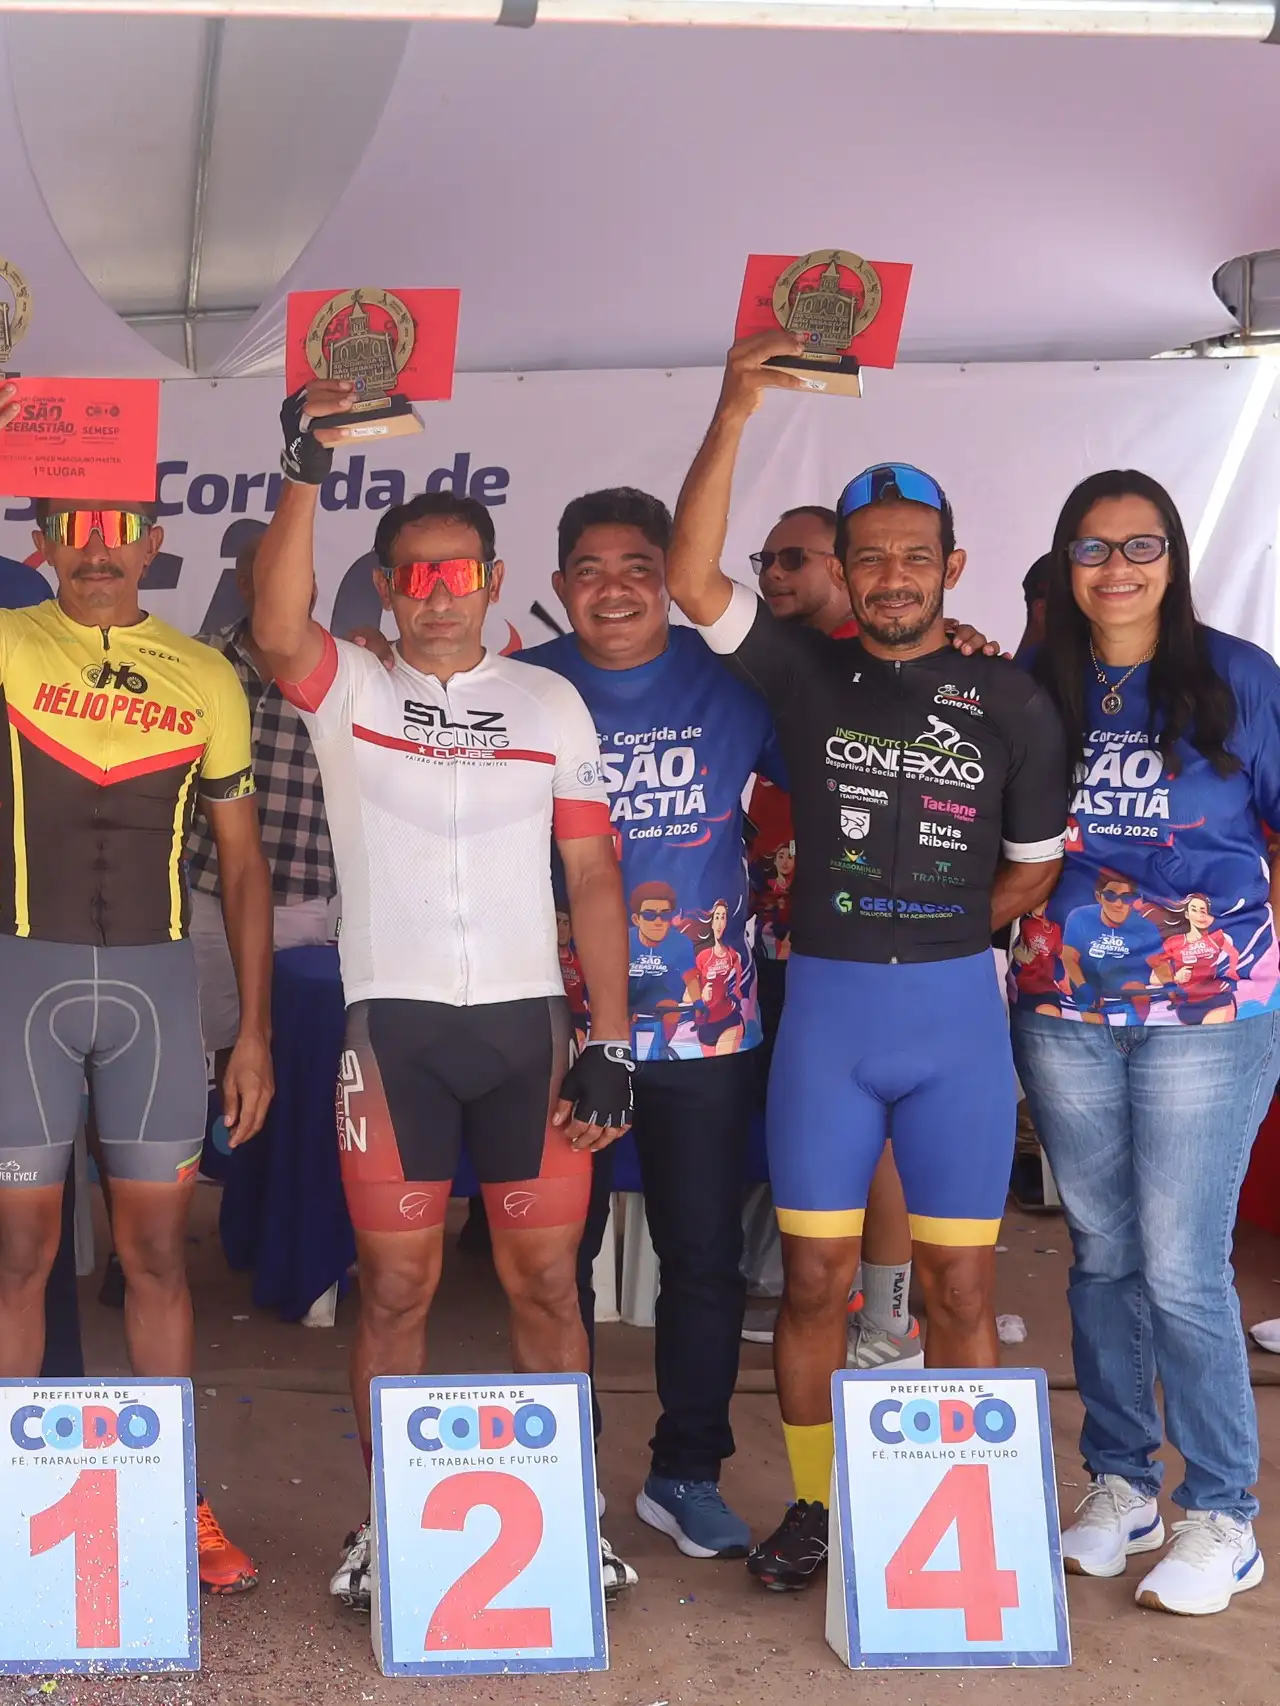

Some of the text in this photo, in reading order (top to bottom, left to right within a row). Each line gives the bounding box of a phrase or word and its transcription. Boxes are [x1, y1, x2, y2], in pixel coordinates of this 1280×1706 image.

[22, 402, 63, 421] SÃO
[5, 421, 75, 434] SEBASTIÃO
[82, 426, 120, 435] SEMESP
[47, 467, 86, 477] LUGAR
[156, 452, 510, 517] Corrda de
[33, 683, 197, 735] HÉLIO PEÇAS
[403, 699, 508, 732] SLZ
[403, 724, 510, 748] CYCLING
[613, 726, 677, 746] Corrida
[680, 726, 702, 740] de
[835, 726, 909, 750] INSTITUTO
[1088, 729, 1149, 744] Corrida
[433, 749, 496, 759] CLUBE
[599, 741, 696, 794] SÃO
[825, 757, 864, 772] Desportiva
[871, 766, 898, 779] Social
[905, 772, 916, 780] de
[918, 773, 976, 791] Paragominas
[839, 784, 889, 800] SCANIA
[609, 783, 707, 822] ASTIÃ
[921, 795, 977, 817] Tatiane
[1070, 787, 1170, 820] ASTIÃ
[628, 822, 699, 840] Codó 2026
[919, 821, 962, 839] Elvis
[1088, 822, 1122, 835] Codó
[1123, 825, 1159, 838] 2026
[919, 834, 968, 851] Ribeiro
[13, 1170, 38, 1182] CYCLE
[33, 1391, 129, 1400] PREFEITURA DE
[428, 1390, 525, 1400] PREFEITURA DE
[891, 1385, 985, 1394] PREFEITURA DE
[10, 1399, 160, 1450] CODÓ
[407, 1398, 557, 1452] CODÓ
[869, 1393, 1017, 1445] CODÓ
[11, 1455, 161, 1467] FÉ, TRABALHO E FUTURO
[409, 1455, 559, 1468] FÉ, TRABALHO E FUTURO
[872, 1449, 1019, 1460] FÉ, TRABALHO E FUTURO
[30, 1469, 120, 1648] 1
[421, 1471, 552, 1651] 2
[885, 1464, 1019, 1641] 4
